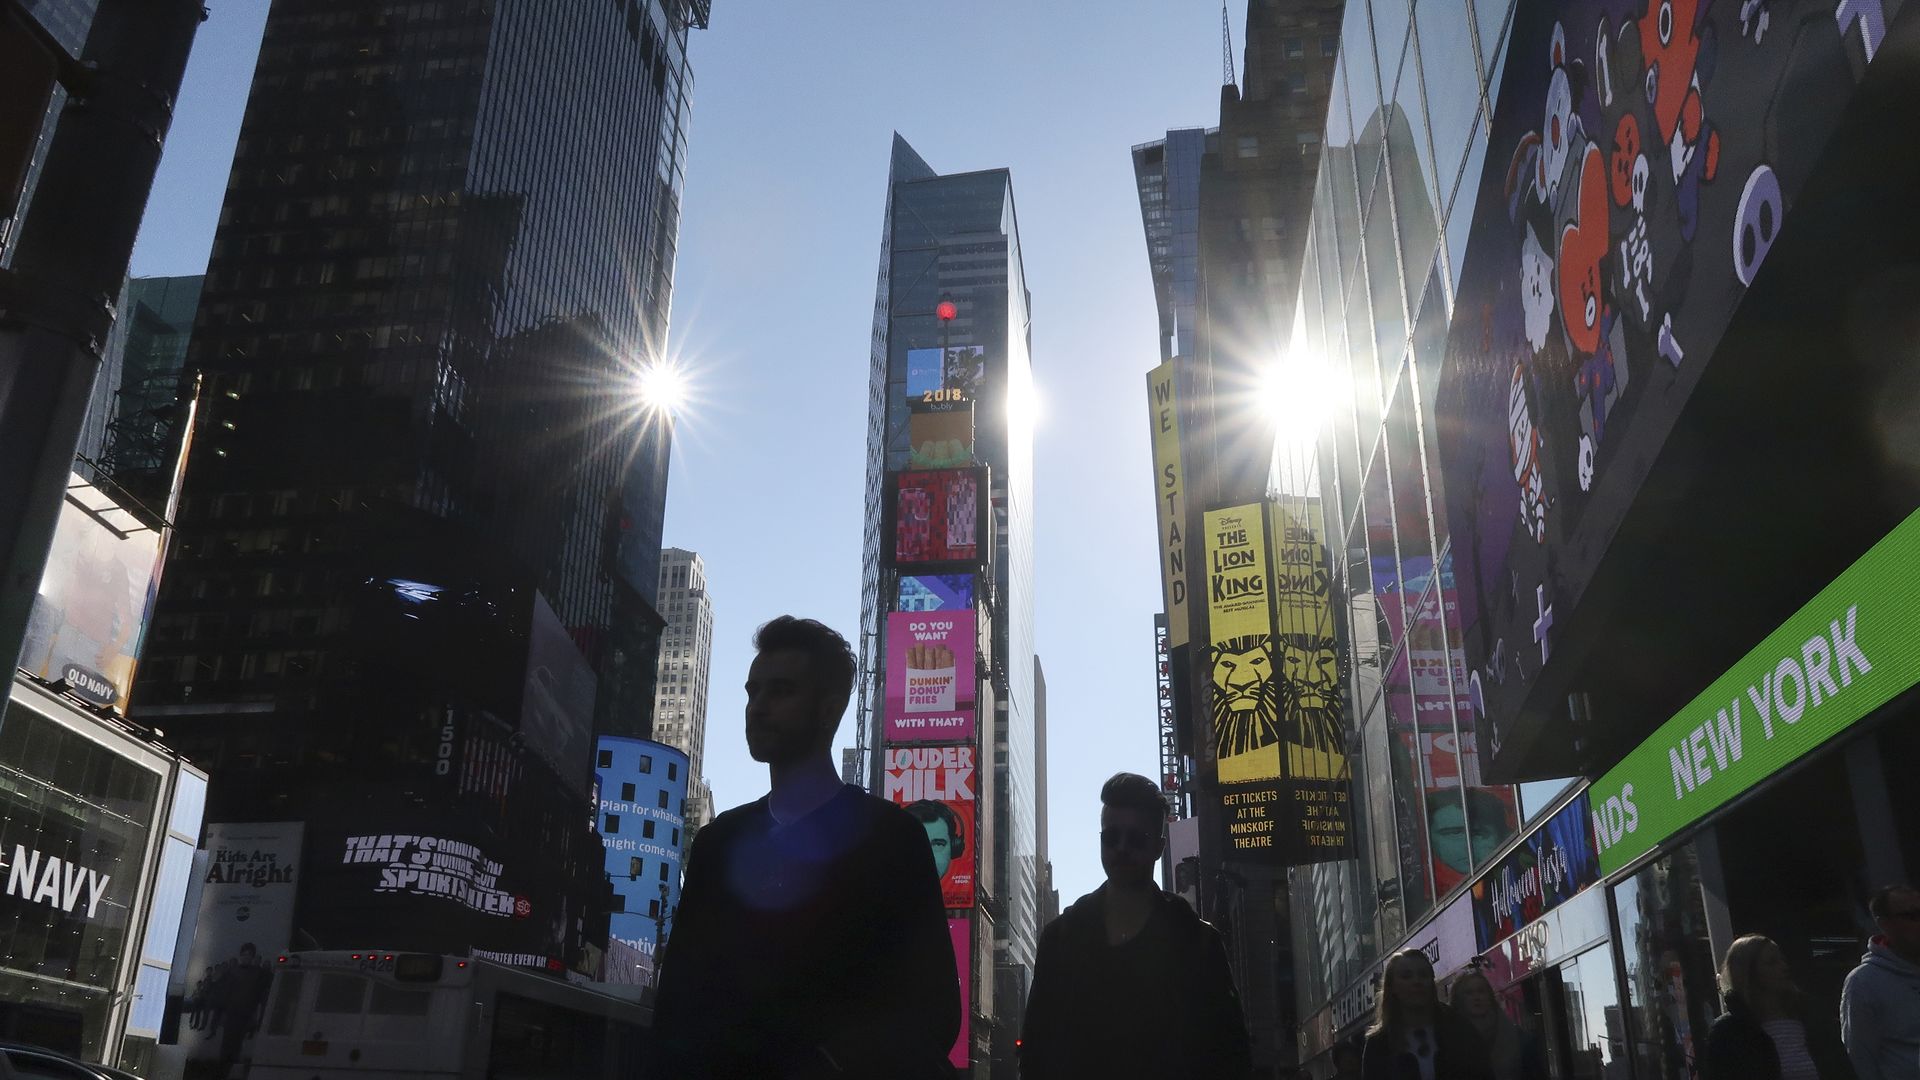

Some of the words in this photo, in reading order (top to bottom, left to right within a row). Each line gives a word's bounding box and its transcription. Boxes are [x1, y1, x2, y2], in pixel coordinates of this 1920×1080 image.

[923, 388, 962, 402] 2018
[1155, 379, 1172, 434] WE
[1164, 463, 1186, 606] STAND
[1217, 529, 1247, 546] THE
[1213, 550, 1256, 574] LION
[1212, 574, 1264, 603] KING
[909, 622, 926, 632] DO
[930, 621, 954, 631] YOU
[914, 631, 948, 641] WANT
[68, 668, 88, 688] OLD
[86, 675, 114, 700] NAVY
[909, 676, 953, 687] DUNKIN'
[909, 685, 947, 696] DONUT
[909, 695, 938, 705] FRIES
[1668, 696, 1743, 801] NEW
[1747, 603, 1873, 741] YORK
[895, 718, 925, 728] WITH
[928, 717, 965, 727] THAT?
[884, 747, 974, 770] LOUDER
[884, 768, 976, 802] MILK
[1223, 794, 1241, 806] GET
[1241, 791, 1278, 804] TICKETS
[600, 799, 629, 812] Plan
[632, 803, 649, 816] for
[1237, 808, 1247, 819] AT
[1249, 806, 1266, 818] THE
[1230, 820, 1275, 835] MINSKOFF
[343, 834, 438, 865] THAT'S
[639, 843, 665, 856] come
[1234, 836, 1273, 849] THEATRE
[216, 850, 248, 863] Kids
[250, 850, 277, 863] Are
[6, 843, 110, 919] NAVY
[206, 862, 293, 887] Alright
[514, 953, 537, 967] EVERY
